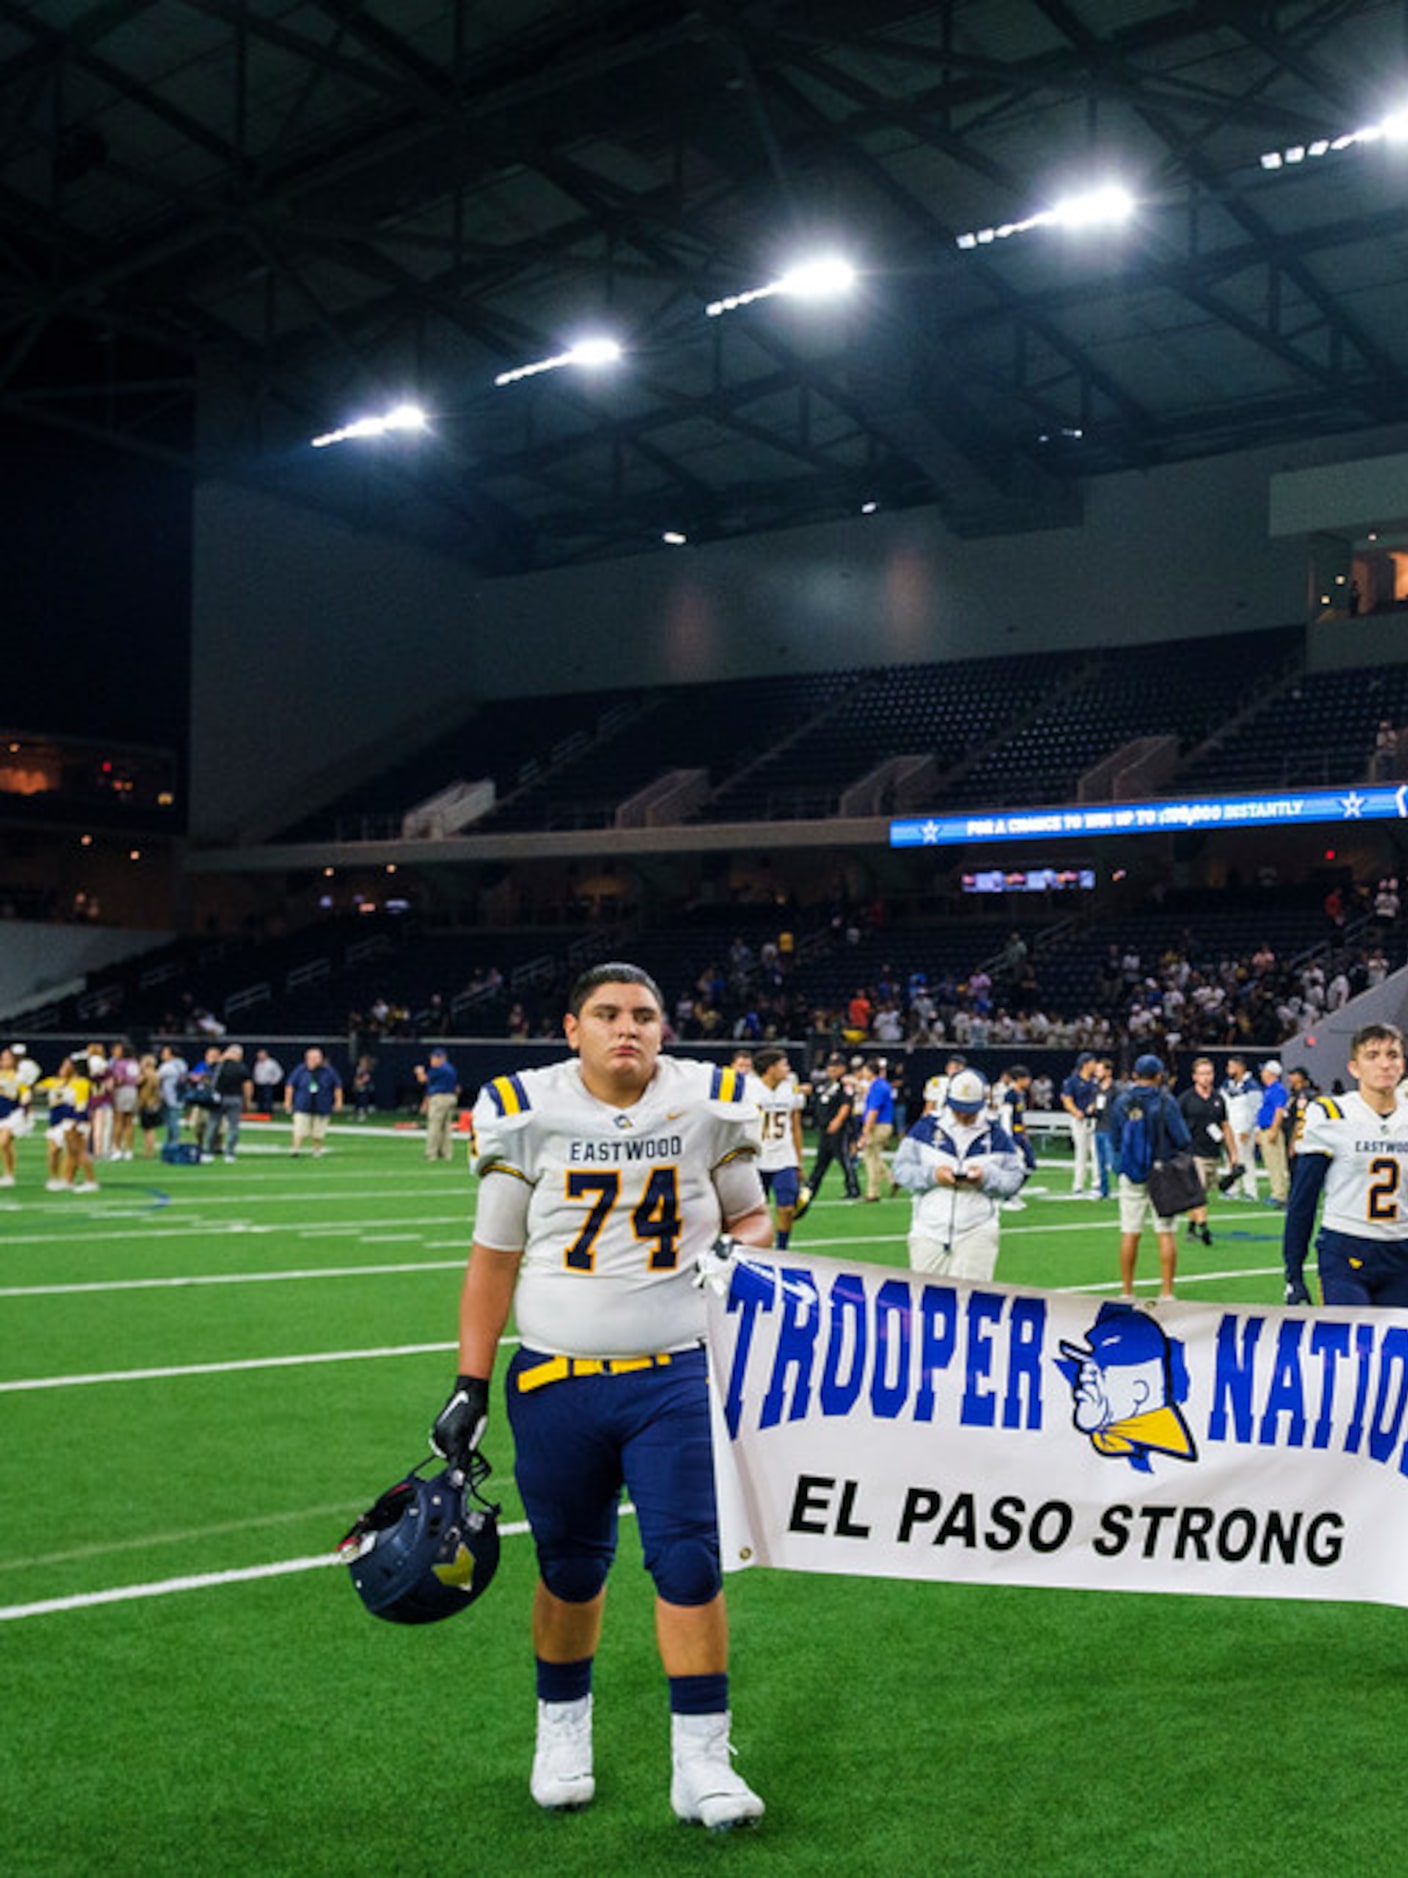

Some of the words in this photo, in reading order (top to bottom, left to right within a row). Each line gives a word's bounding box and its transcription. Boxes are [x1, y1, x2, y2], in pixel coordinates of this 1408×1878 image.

[570, 1135, 682, 1161] EASTWOOD
[1366, 1156, 1399, 1223] 2
[564, 1165, 683, 1273] 74
[726, 1258, 1046, 1441] TROOPER
[787, 1474, 871, 1538] EL
[898, 1487, 1074, 1553] PASO
[1093, 1504, 1346, 1567] STRONG
